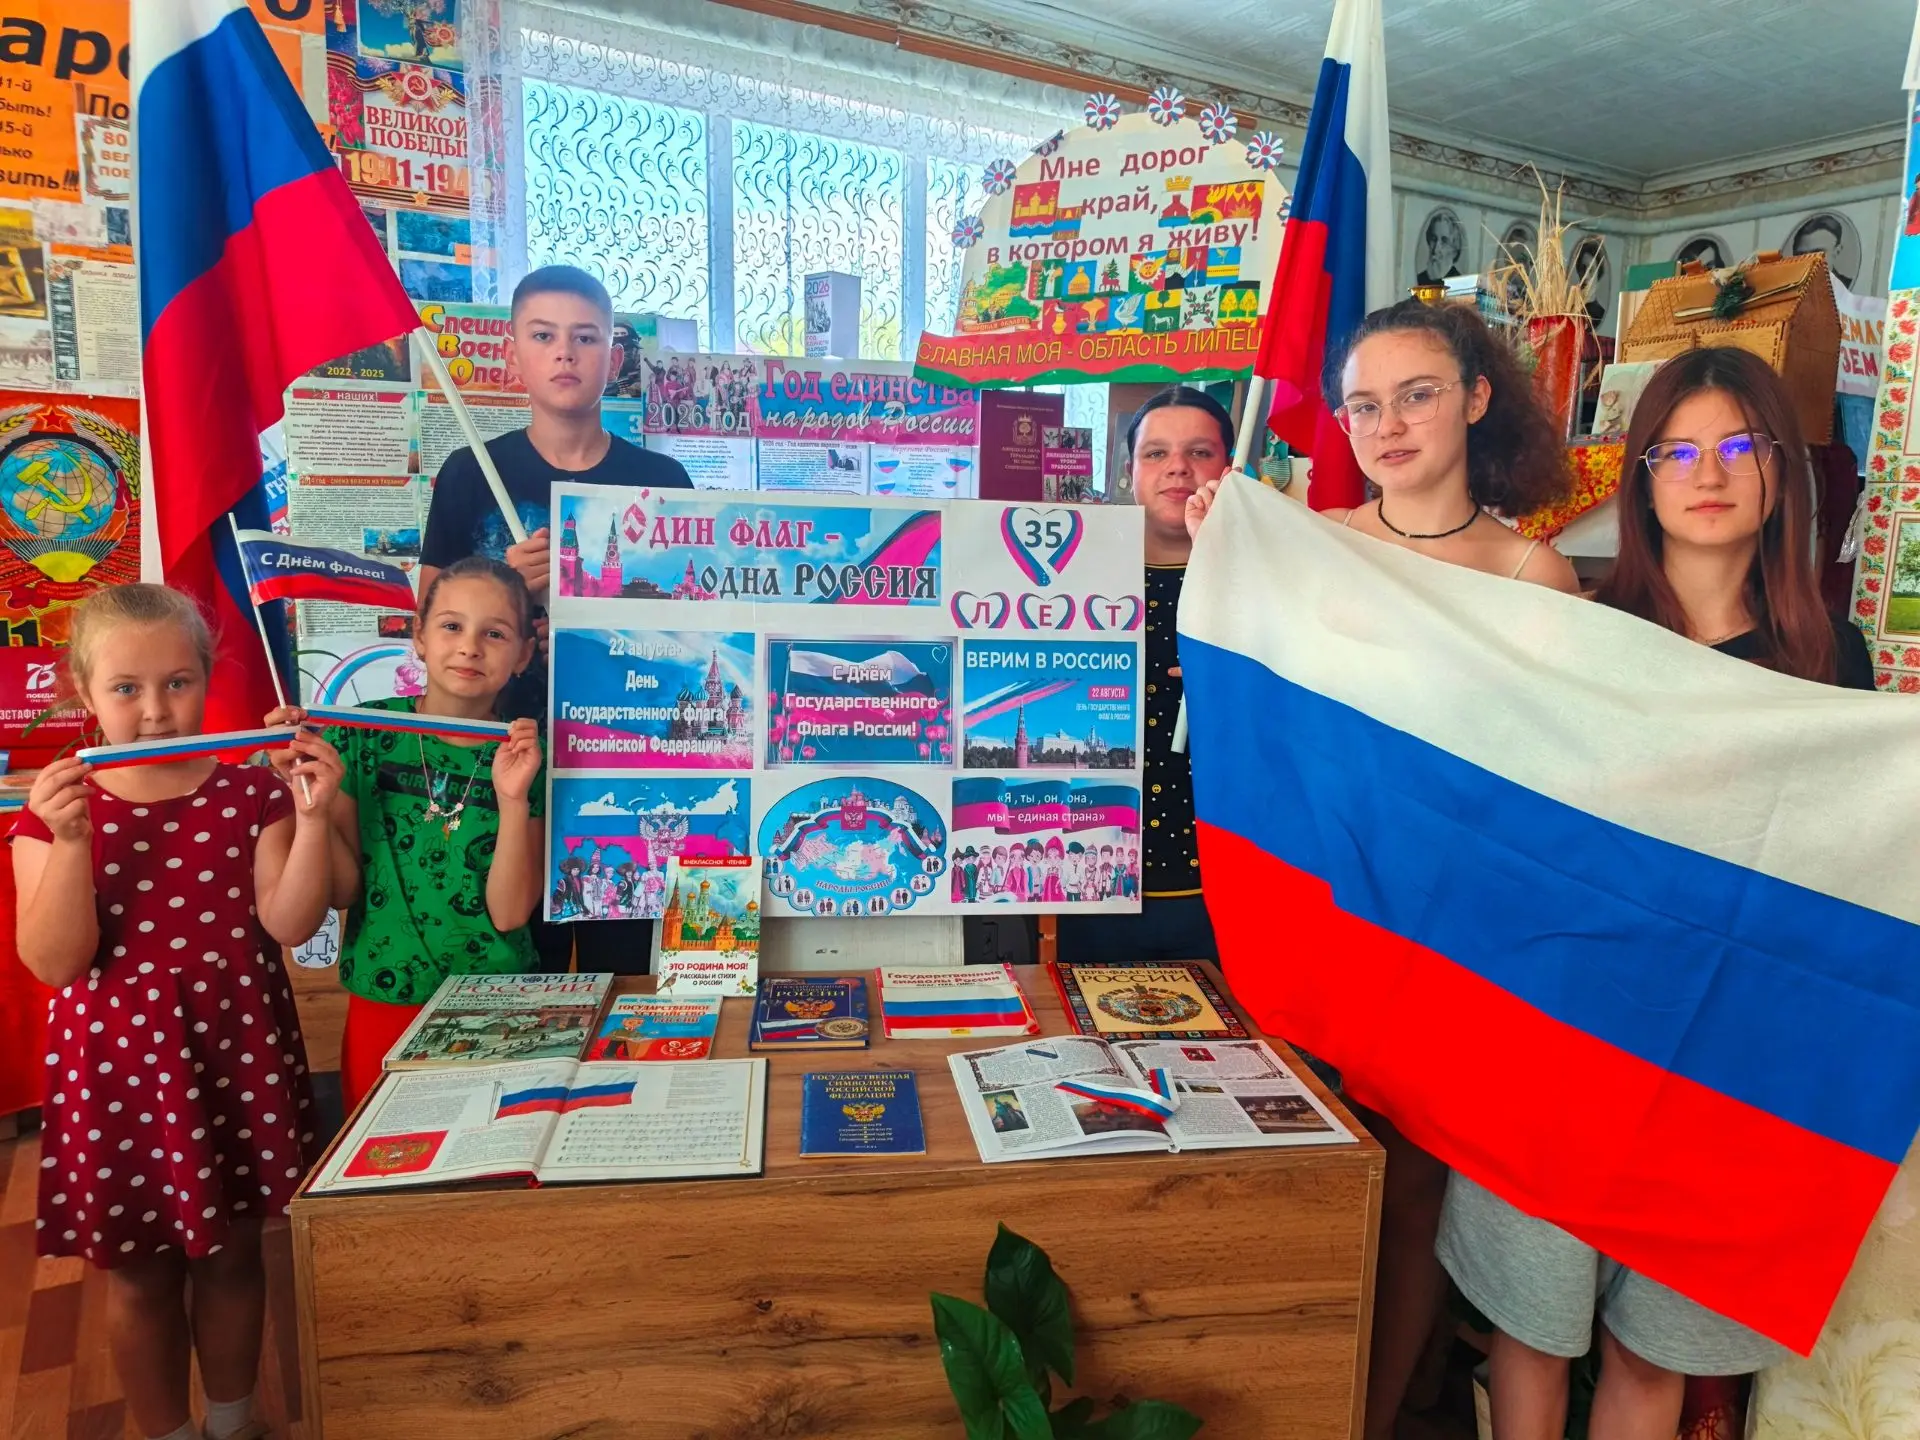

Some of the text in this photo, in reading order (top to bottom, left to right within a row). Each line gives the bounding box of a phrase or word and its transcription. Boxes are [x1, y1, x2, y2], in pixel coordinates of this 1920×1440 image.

[366, 106, 468, 139] ВЕЛИКОЙ
[370, 126, 468, 160] ПОБЕДЫ!
[1040, 144, 1210, 181] Мне дорог
[1081, 186, 1159, 220] край,
[986, 218, 1260, 265] в котором я живу!
[917, 341, 1012, 368] СЛАВНАЯ
[1016, 341, 1062, 364] МОЯ
[1079, 329, 1179, 361] ОБЛАСТЬ
[327, 367, 352, 376] 2022
[361, 368, 385, 378] 2025
[764, 359, 822, 404] Год
[648, 402, 704, 429] 2026
[765, 400, 976, 439] народов России
[1024, 520, 1063, 548] 35
[261, 551, 386, 581] С Днём флага!
[793, 562, 937, 599] РОССИЯ
[609, 637, 625, 656] 22
[966, 651, 1132, 670] ВЕРИМ В РОССИЮ
[26, 662, 57, 690] 75
[625, 670, 660, 692] День
[832, 664, 892, 685] С Днём
[785, 692, 938, 712] Государственного
[1100, 687, 1126, 698] АВГУСТА
[561, 701, 724, 725] Государственного флага
[797, 720, 917, 737] Флага России!
[567, 734, 723, 758] Российской Федерации
[1067, 794, 1087, 803] она
[987, 813, 1006, 822] мы
[1018, 814, 1059, 824] единая
[1062, 813, 1106, 824] страна»
[669, 962, 749, 971] ЭТО РОДИНА МОЯ!
[1080, 974, 1192, 983] РОССИИ
[455, 983, 594, 994] РОССИИ
[811, 1073, 911, 1081] ГОСУДАРСТВЕННАЯ
